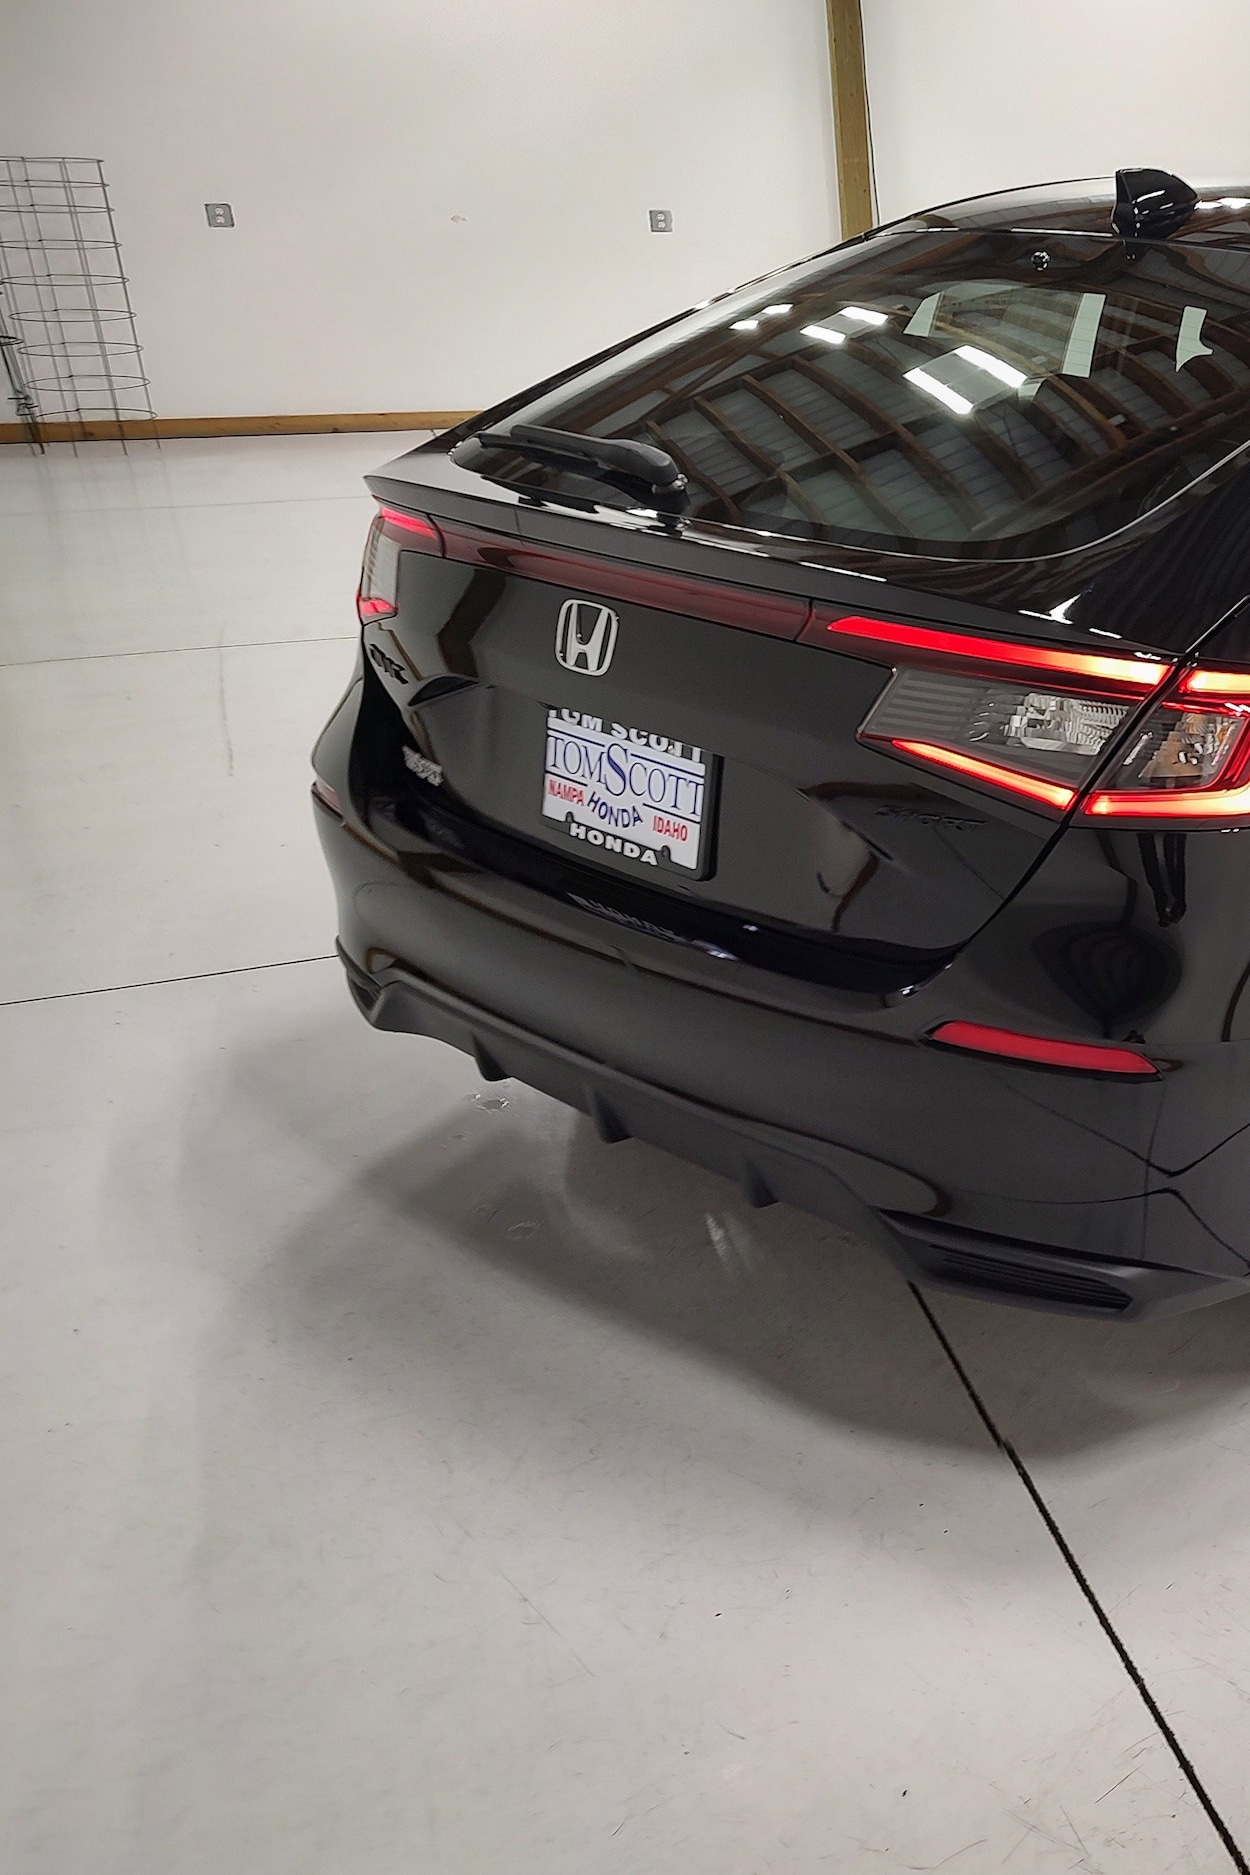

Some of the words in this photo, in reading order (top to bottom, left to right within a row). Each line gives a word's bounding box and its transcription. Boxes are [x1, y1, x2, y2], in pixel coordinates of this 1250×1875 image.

[548, 779, 584, 806] NAMPA
[587, 791, 643, 828] HONDA
[569, 822, 659, 866] HONDA
[653, 815, 688, 842] IDAHO
